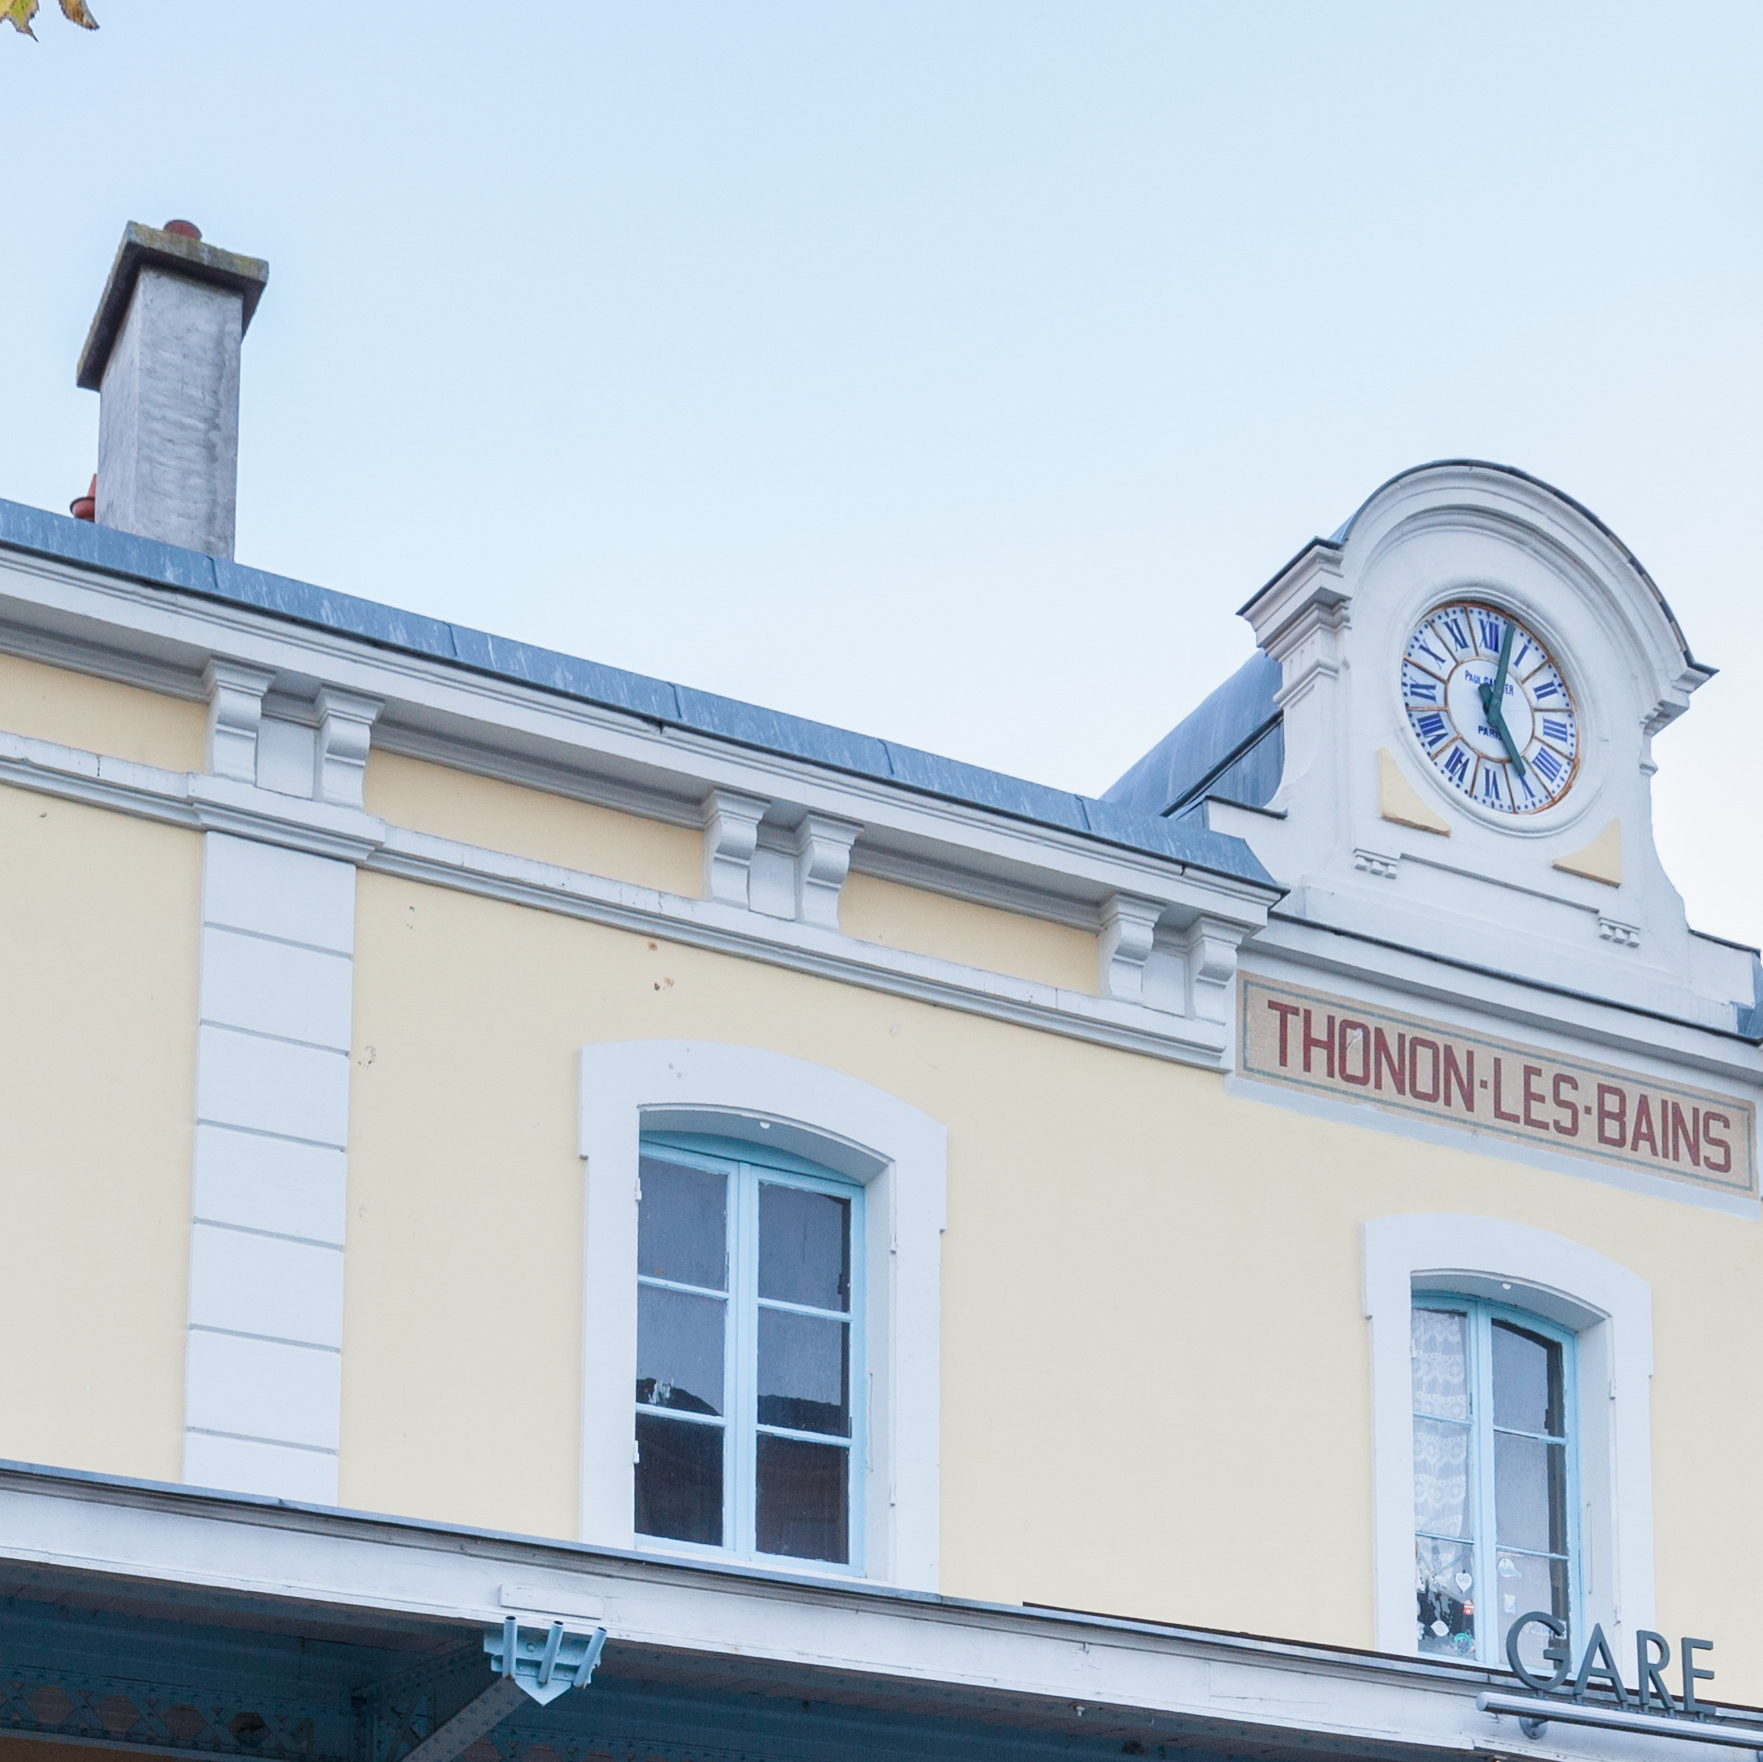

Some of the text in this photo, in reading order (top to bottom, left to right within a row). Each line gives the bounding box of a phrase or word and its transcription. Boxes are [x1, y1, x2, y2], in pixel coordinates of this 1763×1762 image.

[1478, 618, 1500, 653] XII
[1464, 670, 1481, 685] PAUL
[1506, 1611, 1716, 1715] GARE
